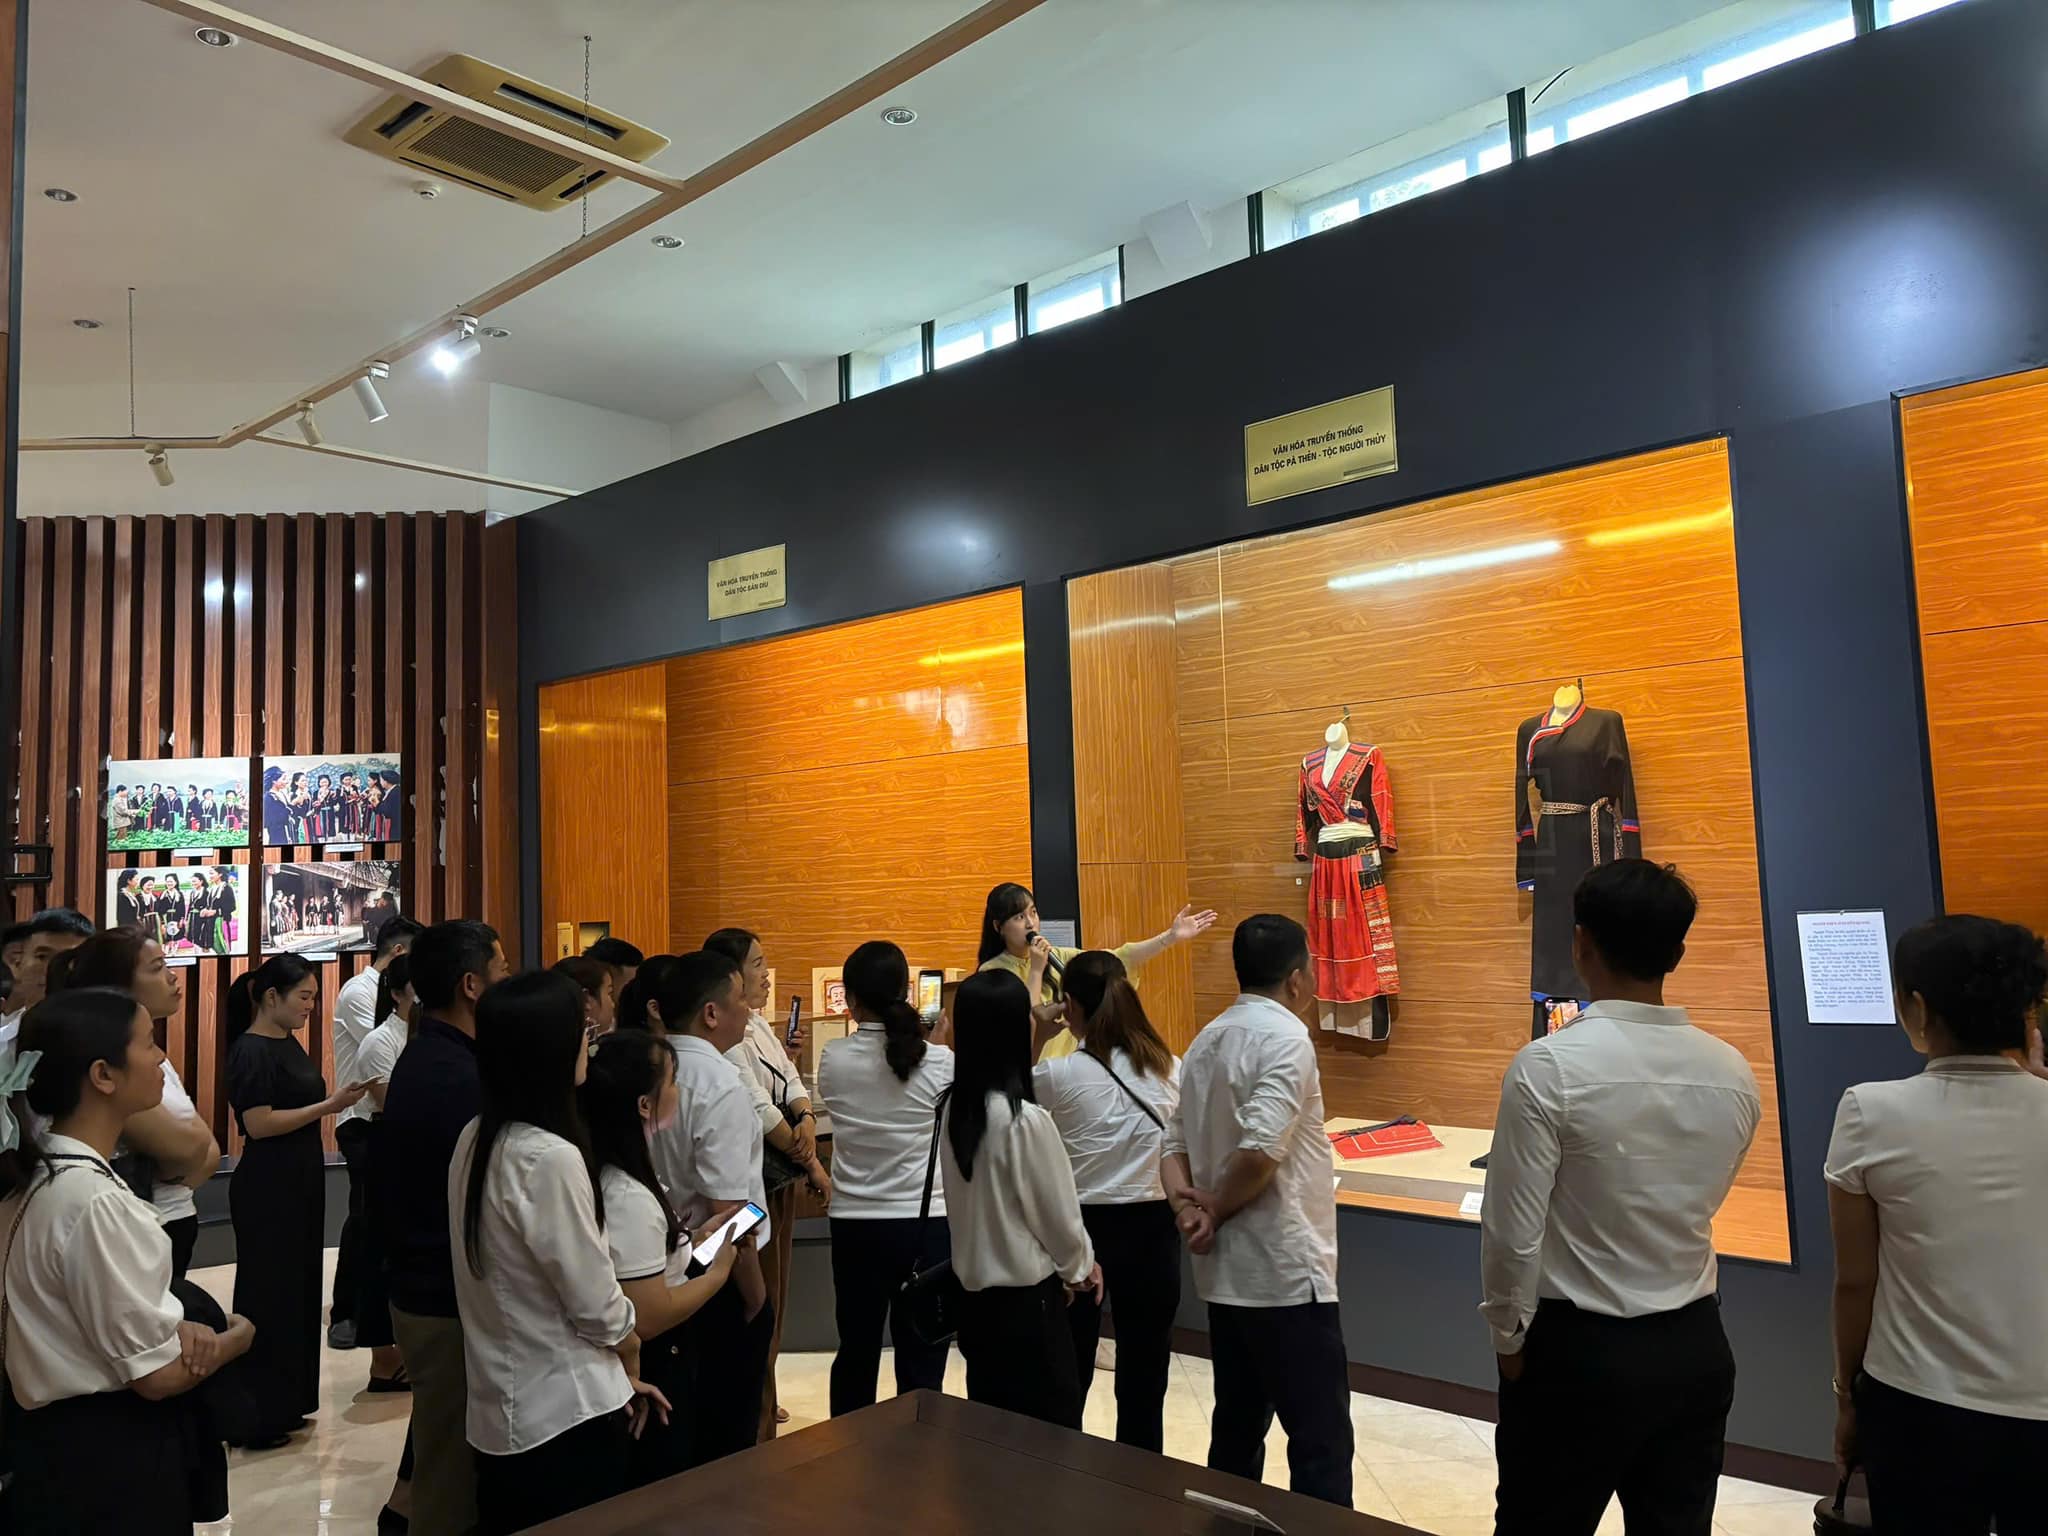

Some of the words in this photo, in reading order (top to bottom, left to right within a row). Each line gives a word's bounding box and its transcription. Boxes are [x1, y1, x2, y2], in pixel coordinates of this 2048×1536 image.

[1337, 425, 1364, 439] THỐNG
[1271, 459, 1286, 472] TỘC
[1322, 446, 1338, 459] TỘC
